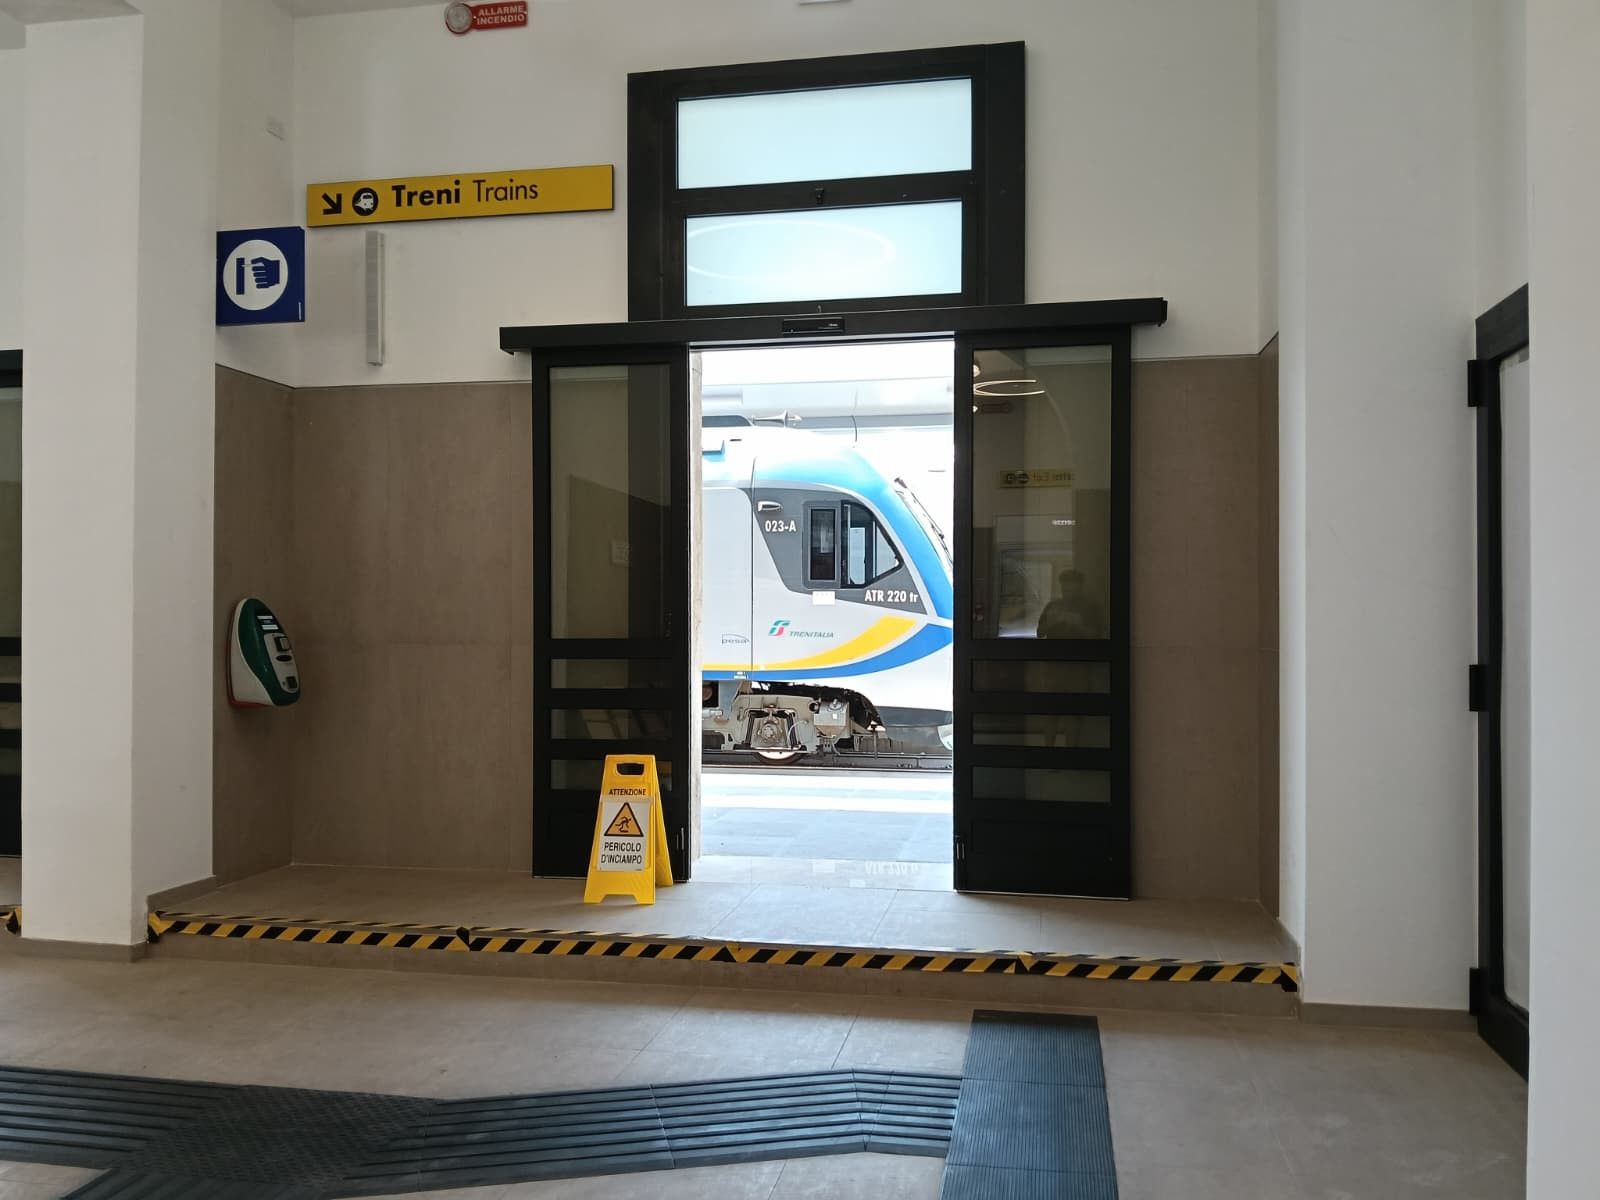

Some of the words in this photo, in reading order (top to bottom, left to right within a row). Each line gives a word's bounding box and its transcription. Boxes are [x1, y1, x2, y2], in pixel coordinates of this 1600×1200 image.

[478, 5, 524, 16] ALLARME
[476, 14, 525, 25] INCENDIO
[391, 180, 461, 208] Treni
[472, 178, 538, 202] Trains
[765, 520, 796, 532] 023-A
[864, 590, 884, 602] ATR
[887, 590, 907, 602] 220
[909, 591, 919, 602] tr
[609, 788, 646, 796] ATTENZIONE
[603, 842, 641, 852] PERICOLO
[601, 854, 642, 864] D'INCIAMPO
